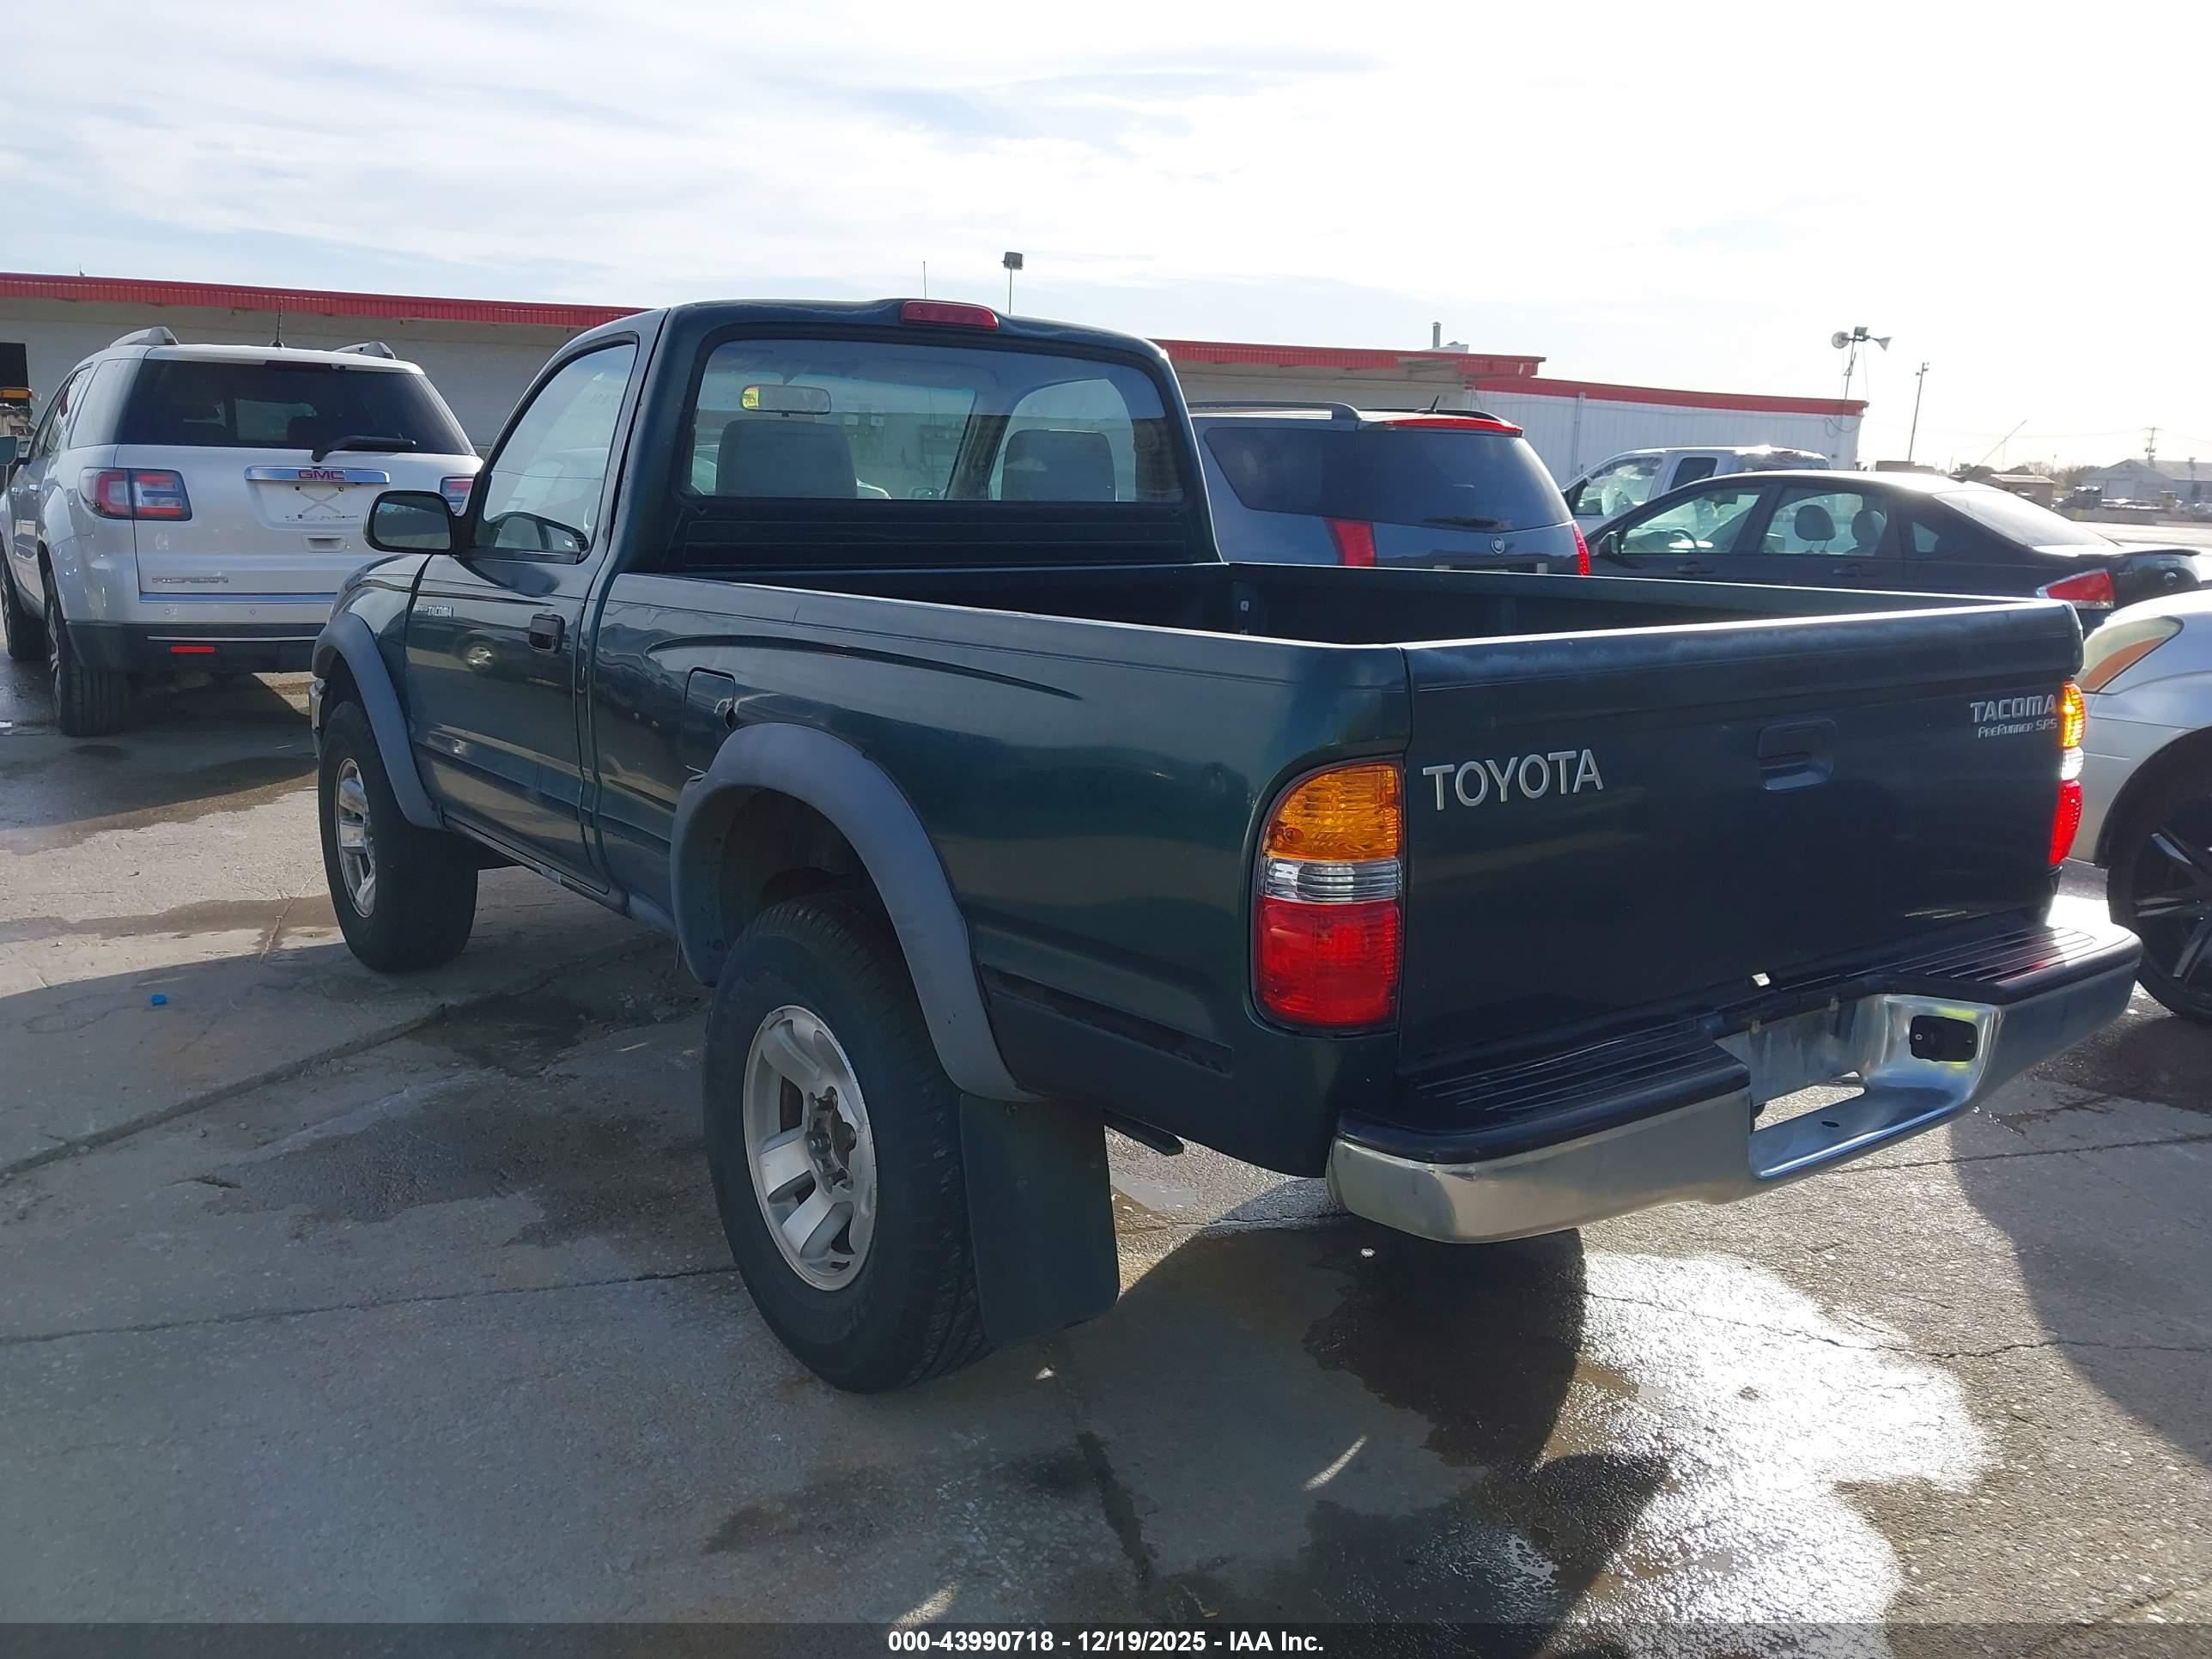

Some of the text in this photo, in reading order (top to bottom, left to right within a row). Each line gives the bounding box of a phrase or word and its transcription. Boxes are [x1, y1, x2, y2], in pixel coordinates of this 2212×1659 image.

[297, 470, 345, 481] GMC
[1970, 693, 2057, 723] TACOMA
[1422, 749, 1604, 811] TOYOTA
